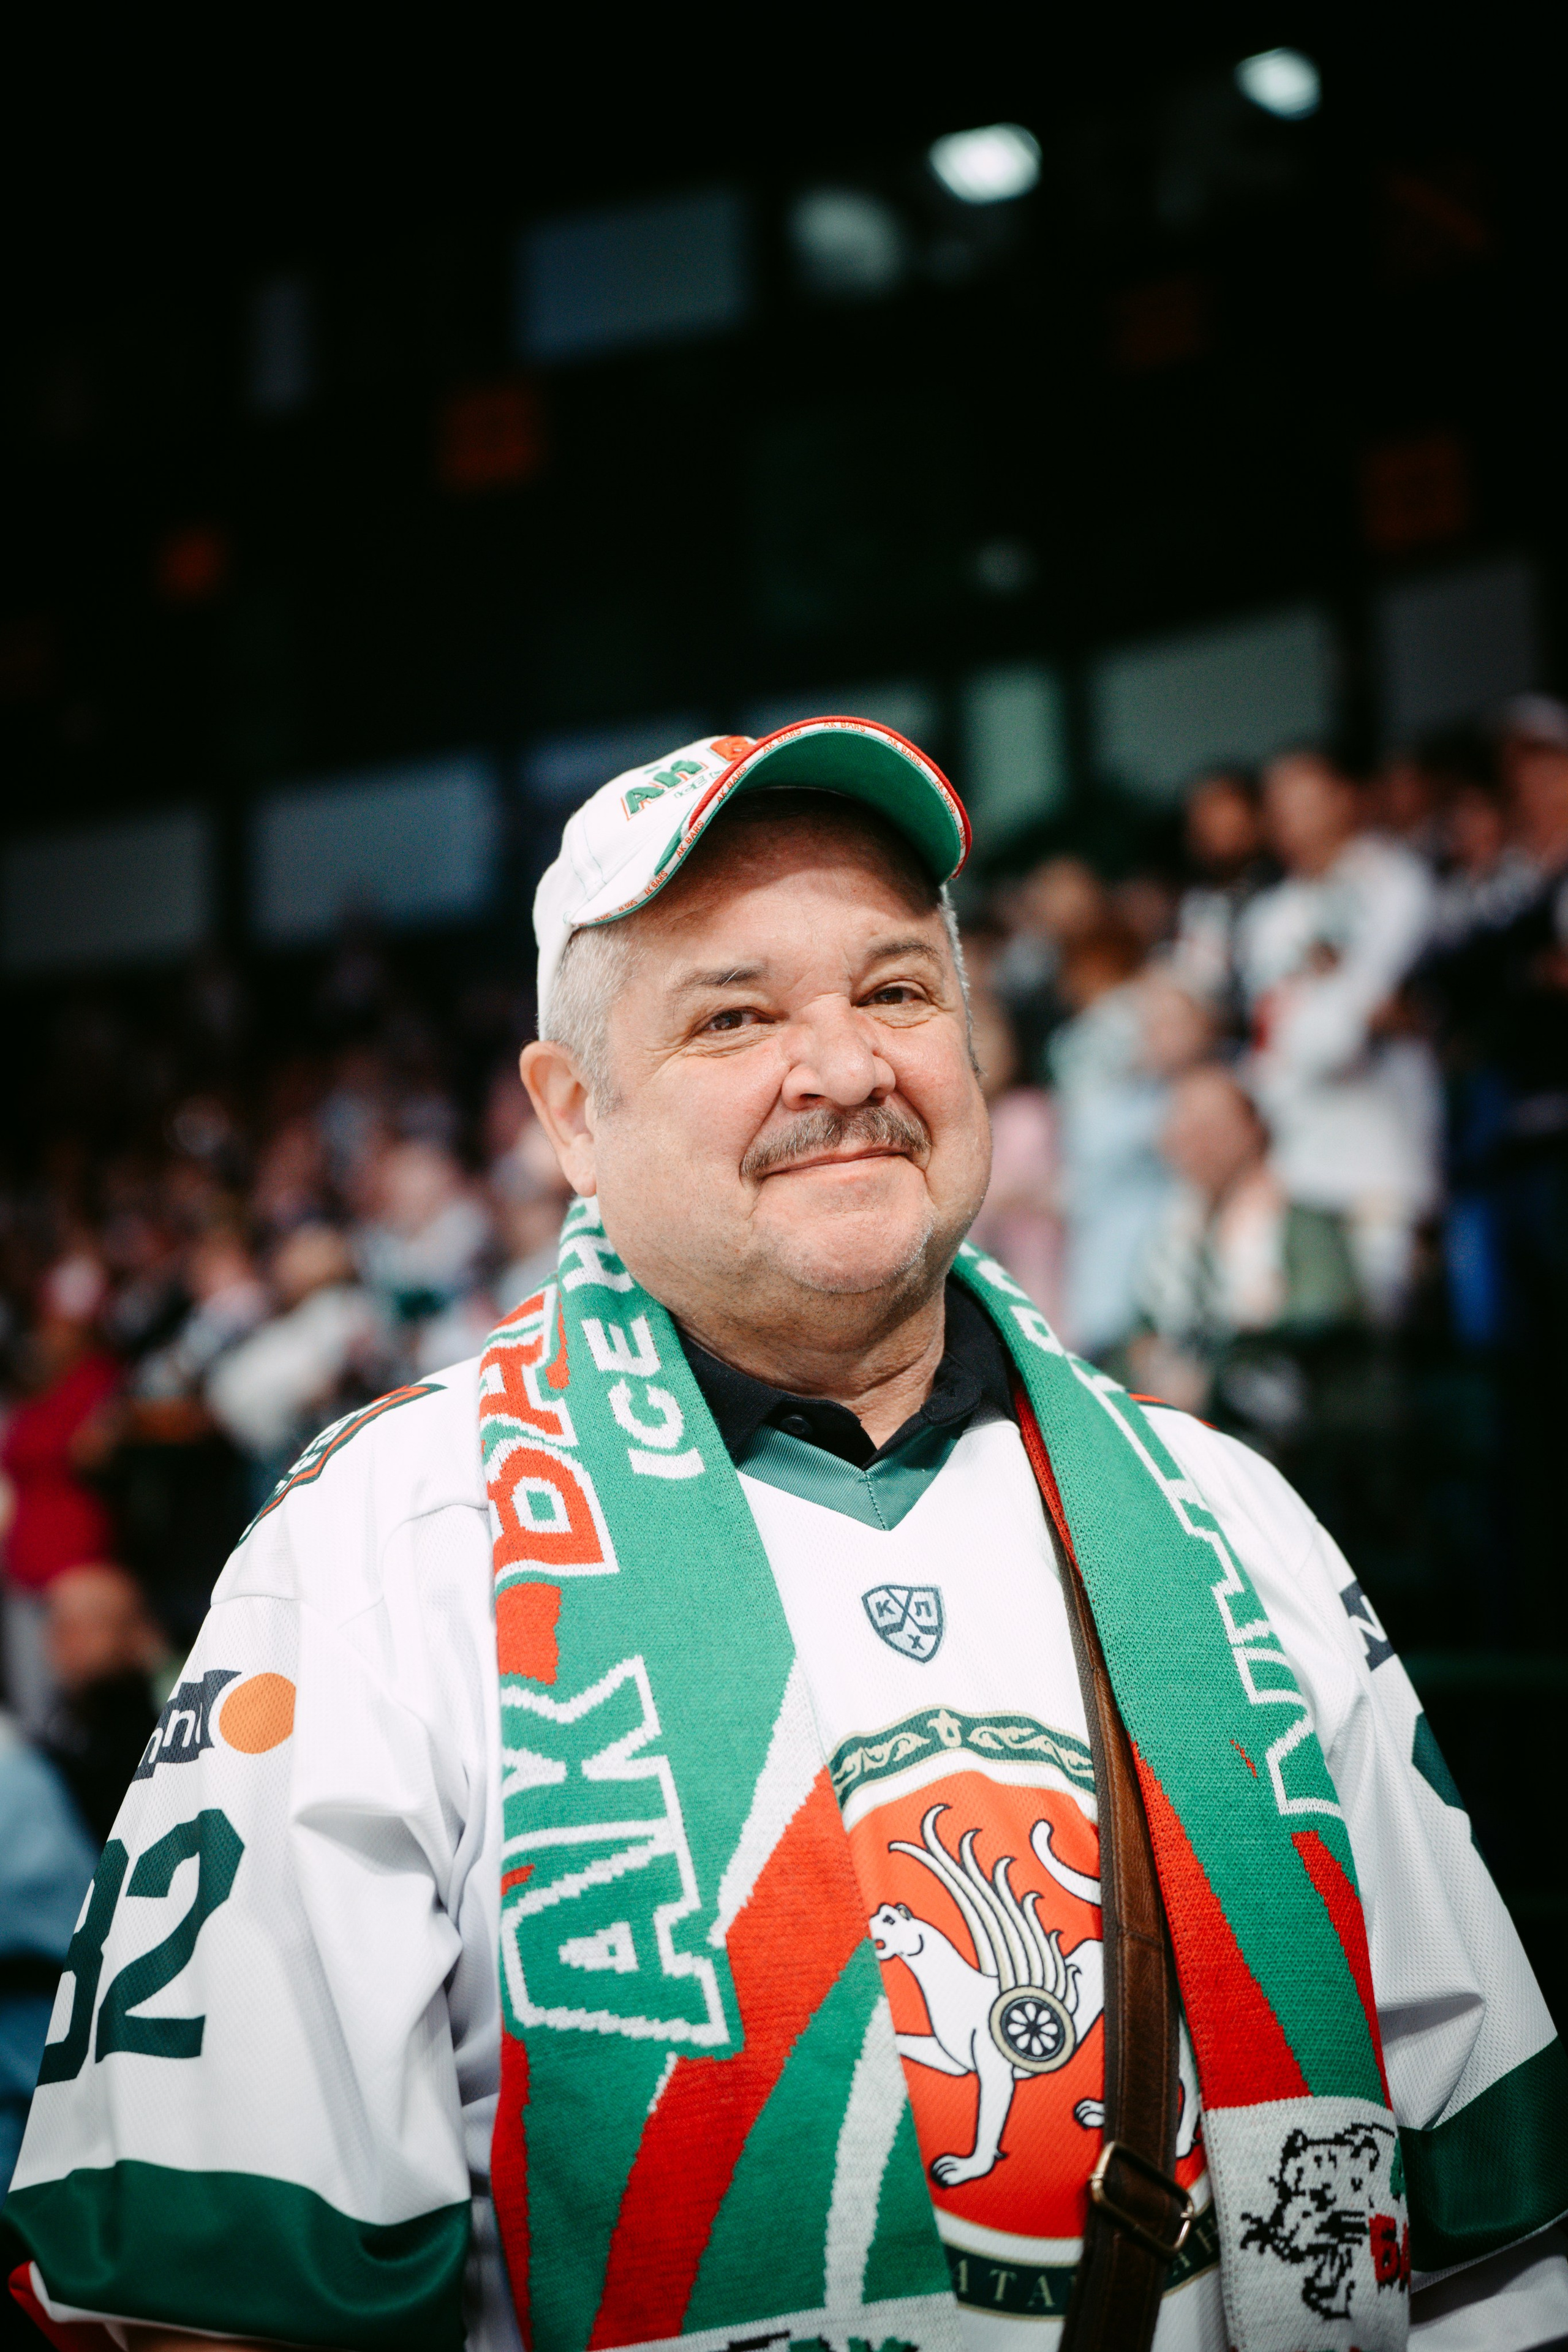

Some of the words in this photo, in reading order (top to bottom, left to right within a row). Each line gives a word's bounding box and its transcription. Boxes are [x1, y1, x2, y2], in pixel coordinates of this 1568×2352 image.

[762, 742, 775, 753] AK
[777, 729, 802, 743] BARS
[840, 722, 866, 733] BARS
[887, 736, 899, 748] AK
[901, 747, 922, 767] BARS
[717, 789, 727, 804] AK
[726, 764, 747, 789] BARS
[935, 780, 944, 793] AK
[944, 793, 957, 815] BARS
[676, 845, 687, 858] AK
[685, 820, 704, 845] BARS
[644, 886, 654, 895] AK
[651, 870, 668, 888] BARS
[579, 1311, 706, 1479] ICE
[499, 1654, 731, 2047] AK
